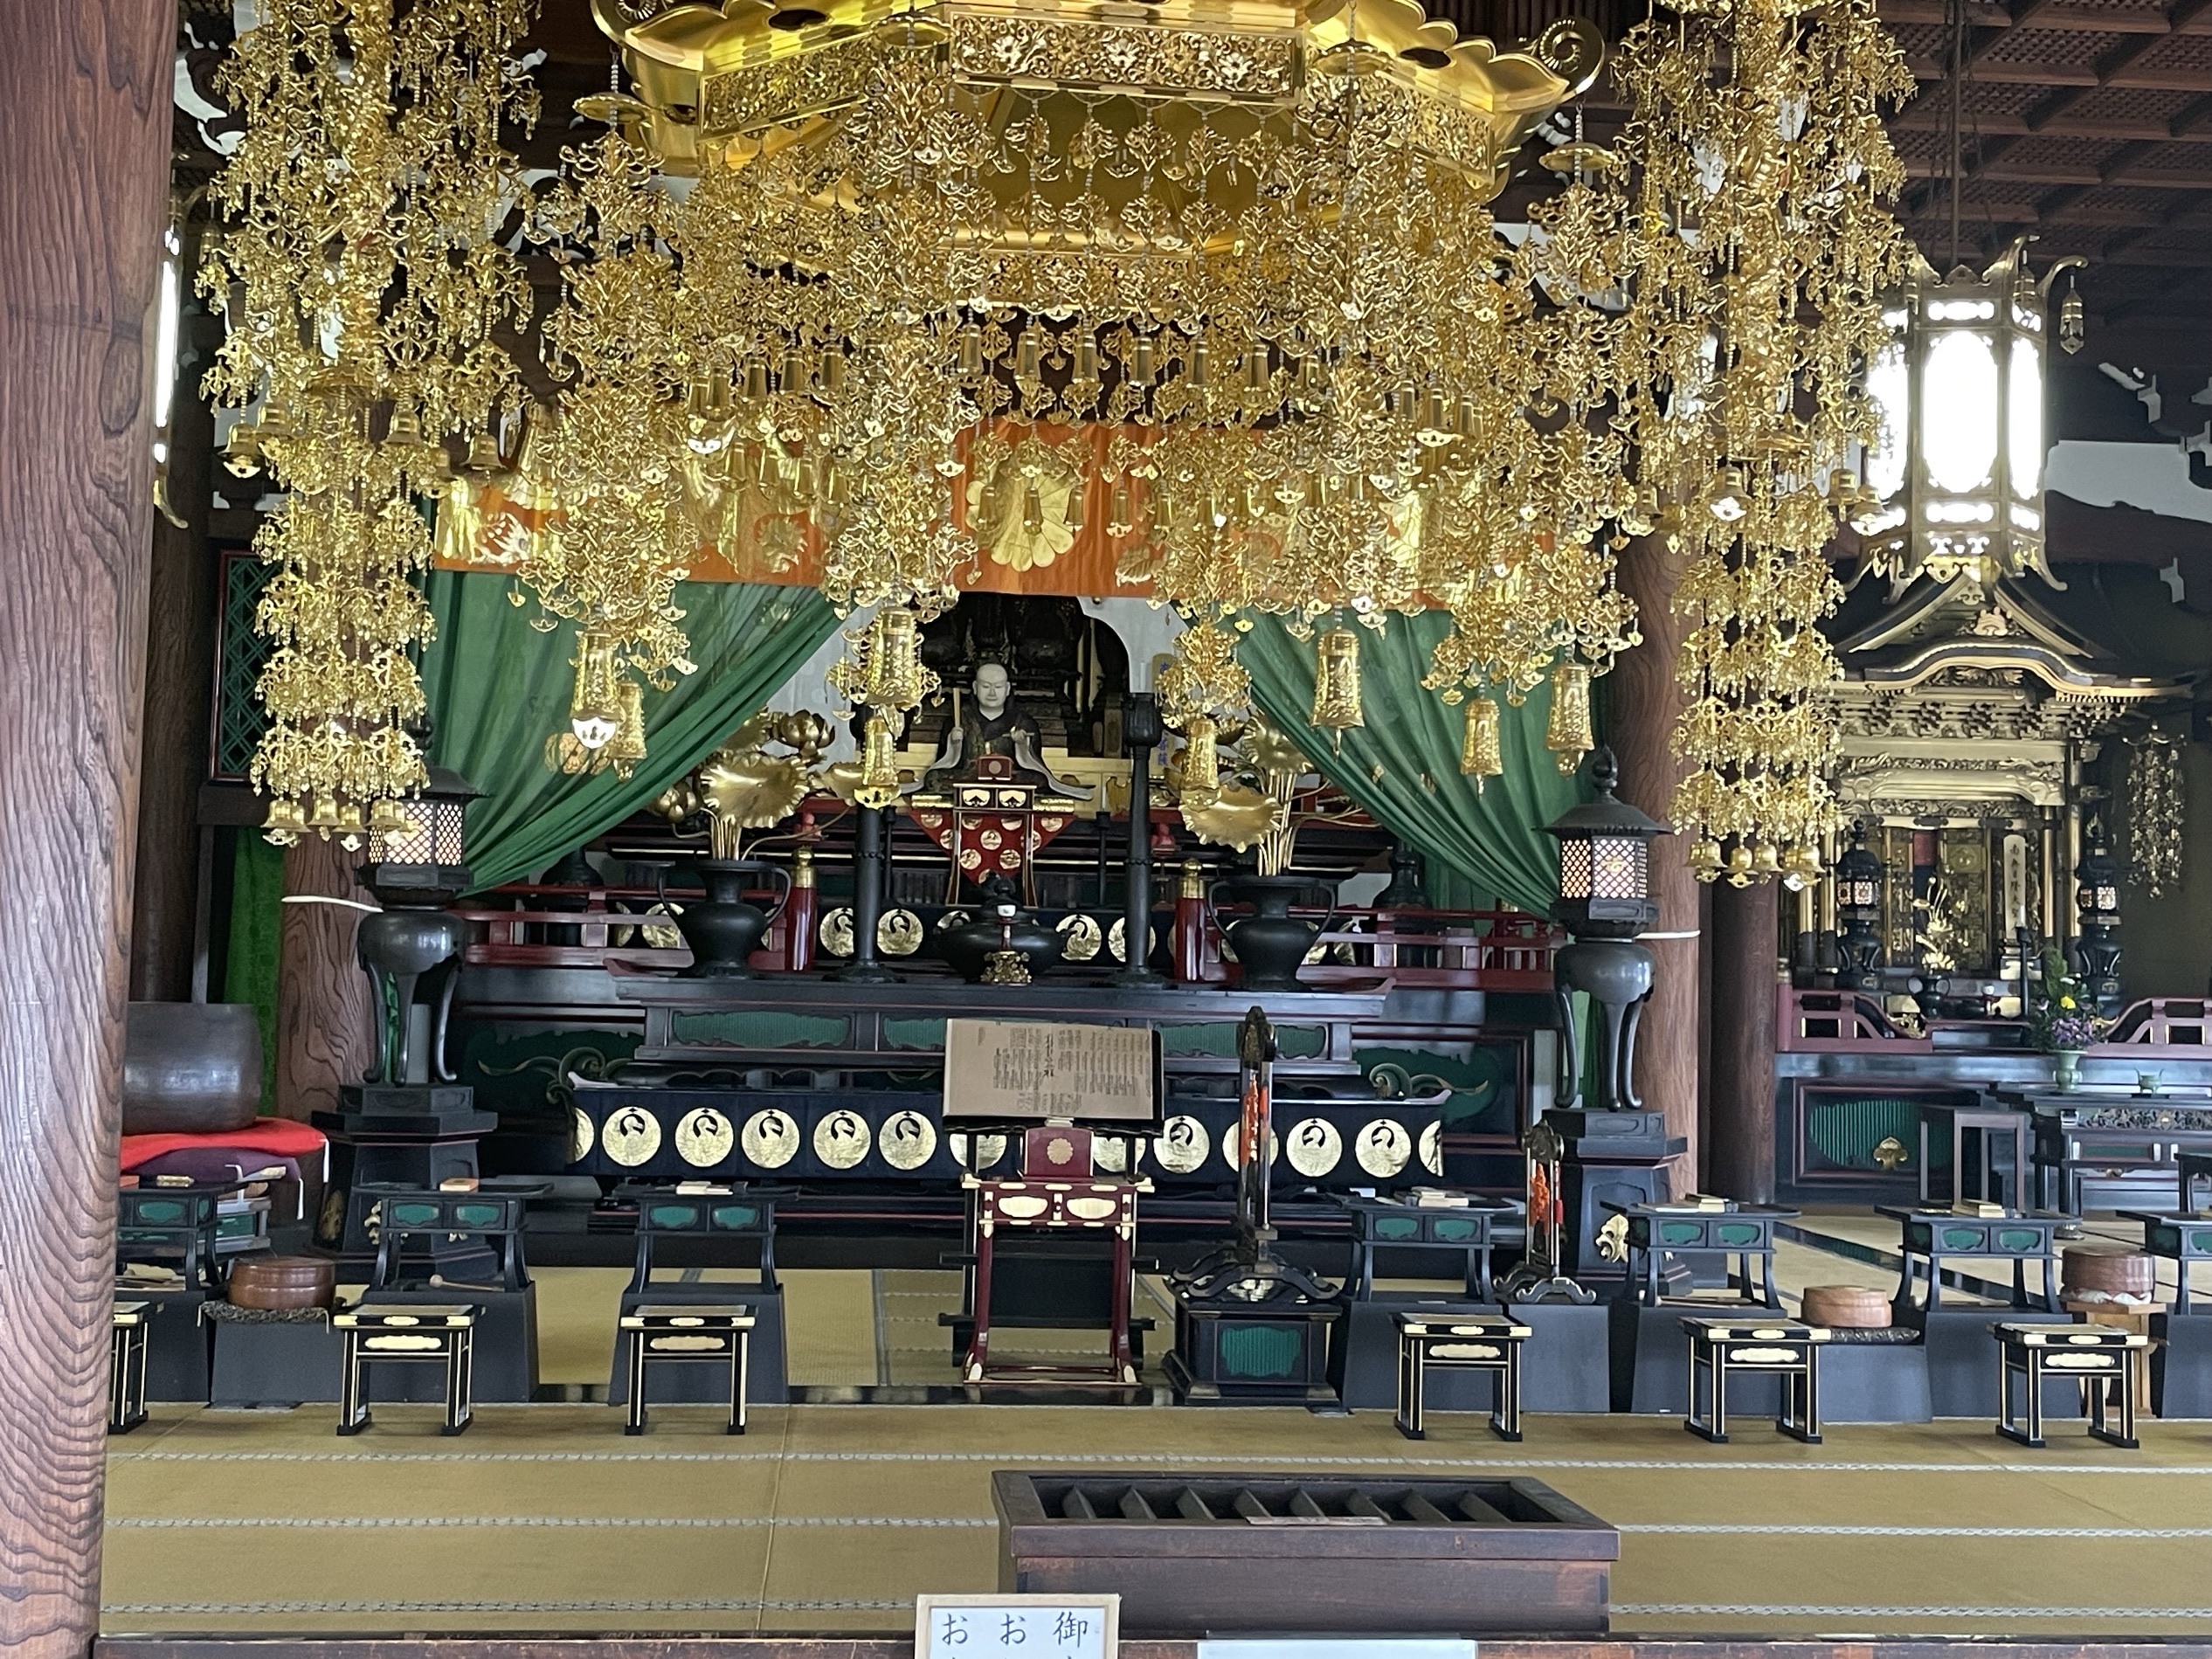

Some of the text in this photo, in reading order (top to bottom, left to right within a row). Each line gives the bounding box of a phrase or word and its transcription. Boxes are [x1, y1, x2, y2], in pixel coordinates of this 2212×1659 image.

[942, 1613, 968, 1659] お
[999, 1613, 1027, 1659] お
[1053, 1611, 1089, 1659] 御
